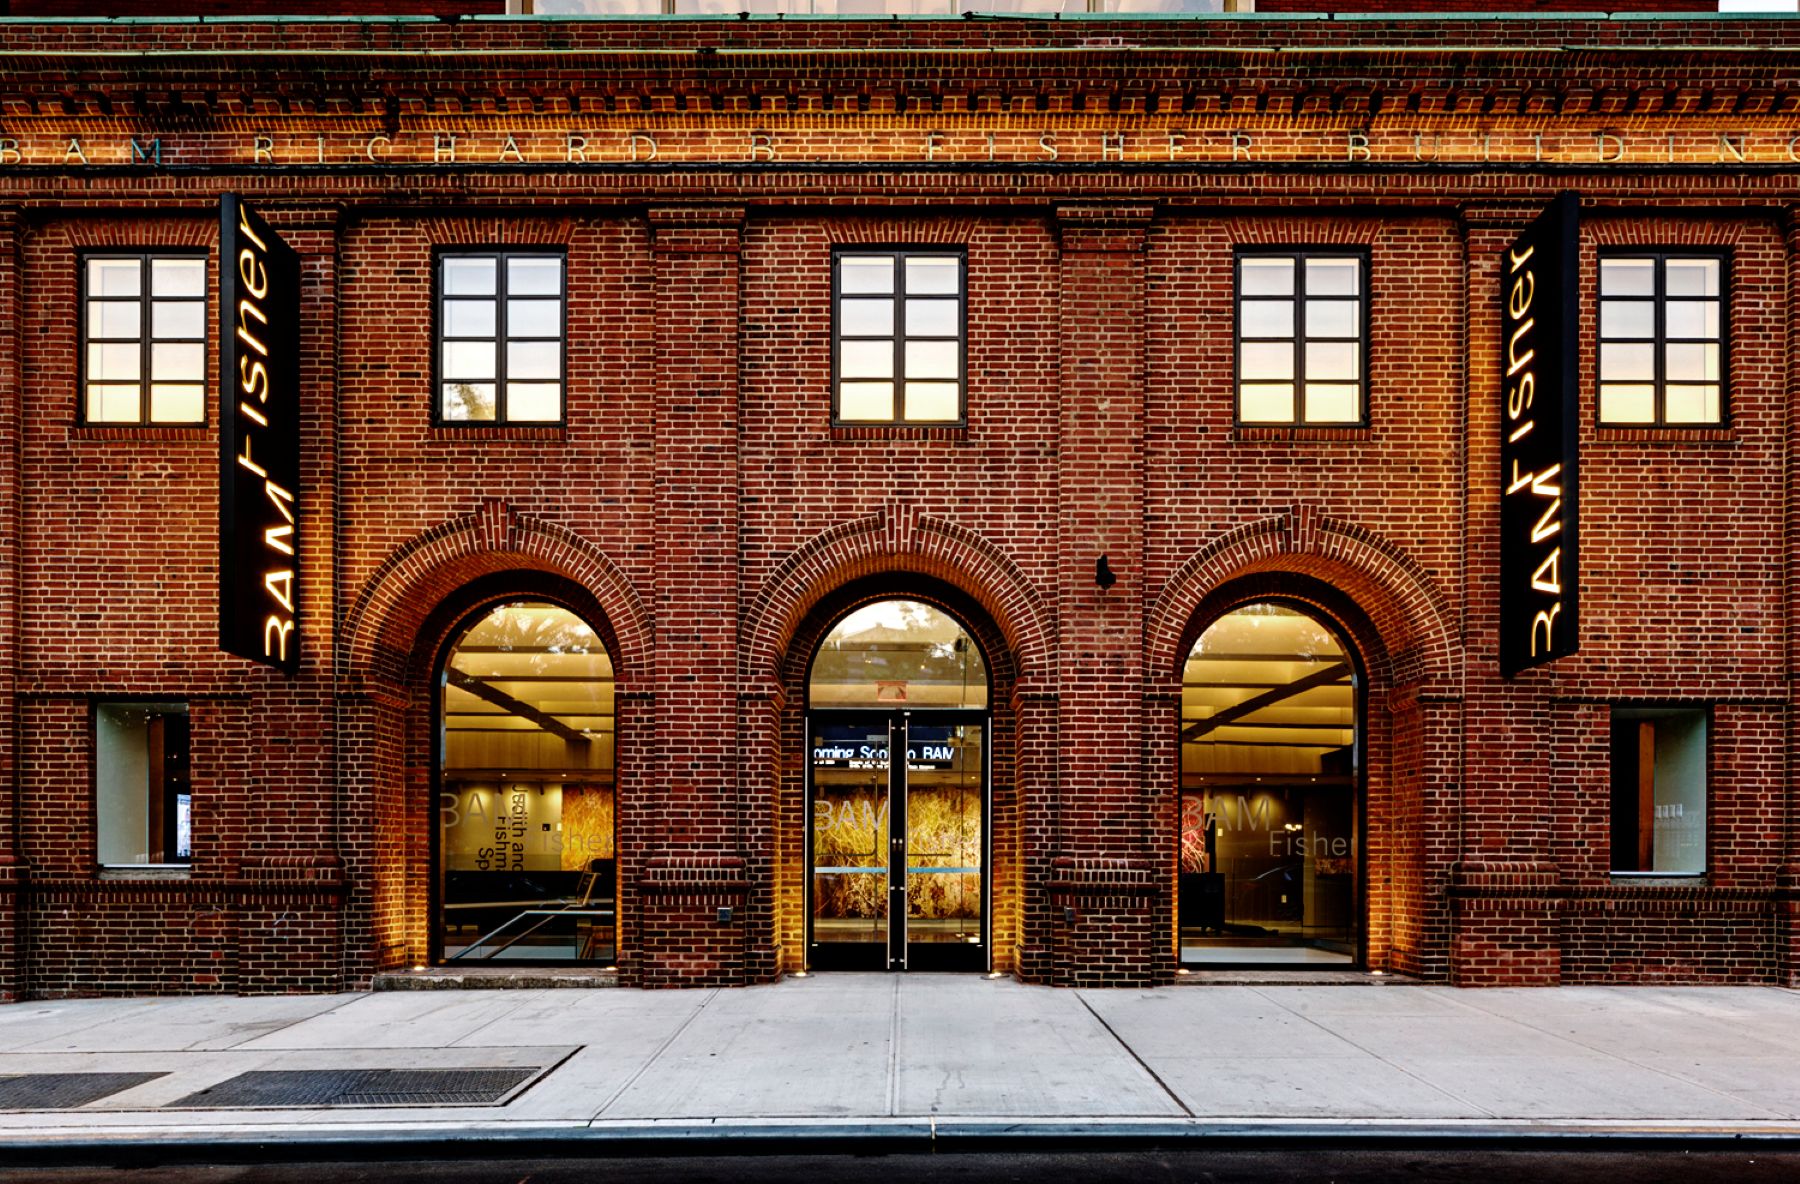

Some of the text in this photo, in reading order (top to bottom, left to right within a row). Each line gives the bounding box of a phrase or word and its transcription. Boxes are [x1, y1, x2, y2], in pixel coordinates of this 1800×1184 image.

[0, 138, 162, 164] BAM
[254, 136, 656, 163] RICHARD
[927, 134, 1254, 162] FISHER
[238, 203, 269, 478] Fisher
[1506, 245, 1535, 496] Fisher
[814, 745, 854, 758] oming
[860, 745, 888, 758] Soo
[496, 816, 511, 871] Fishm
